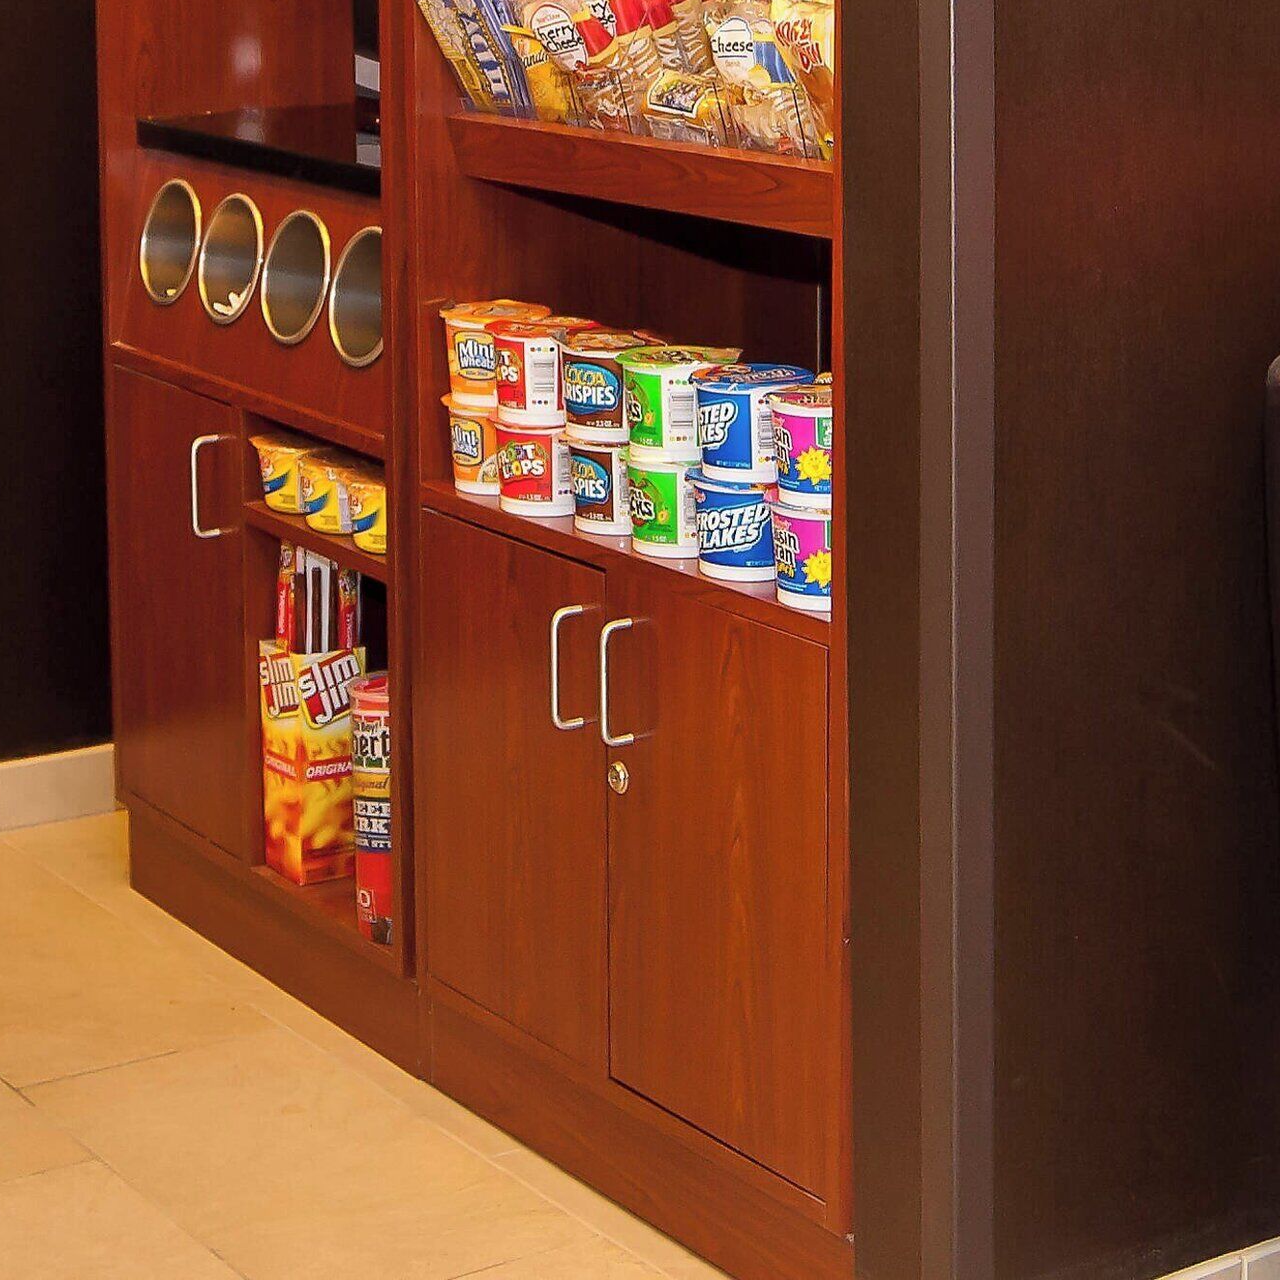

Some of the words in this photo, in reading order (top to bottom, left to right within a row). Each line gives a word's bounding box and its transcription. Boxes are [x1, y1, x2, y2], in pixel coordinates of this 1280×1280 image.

[698, 522, 761, 549] FLAKES
[298, 654, 361, 701] slim
[305, 761, 353, 779] ORIGINA
